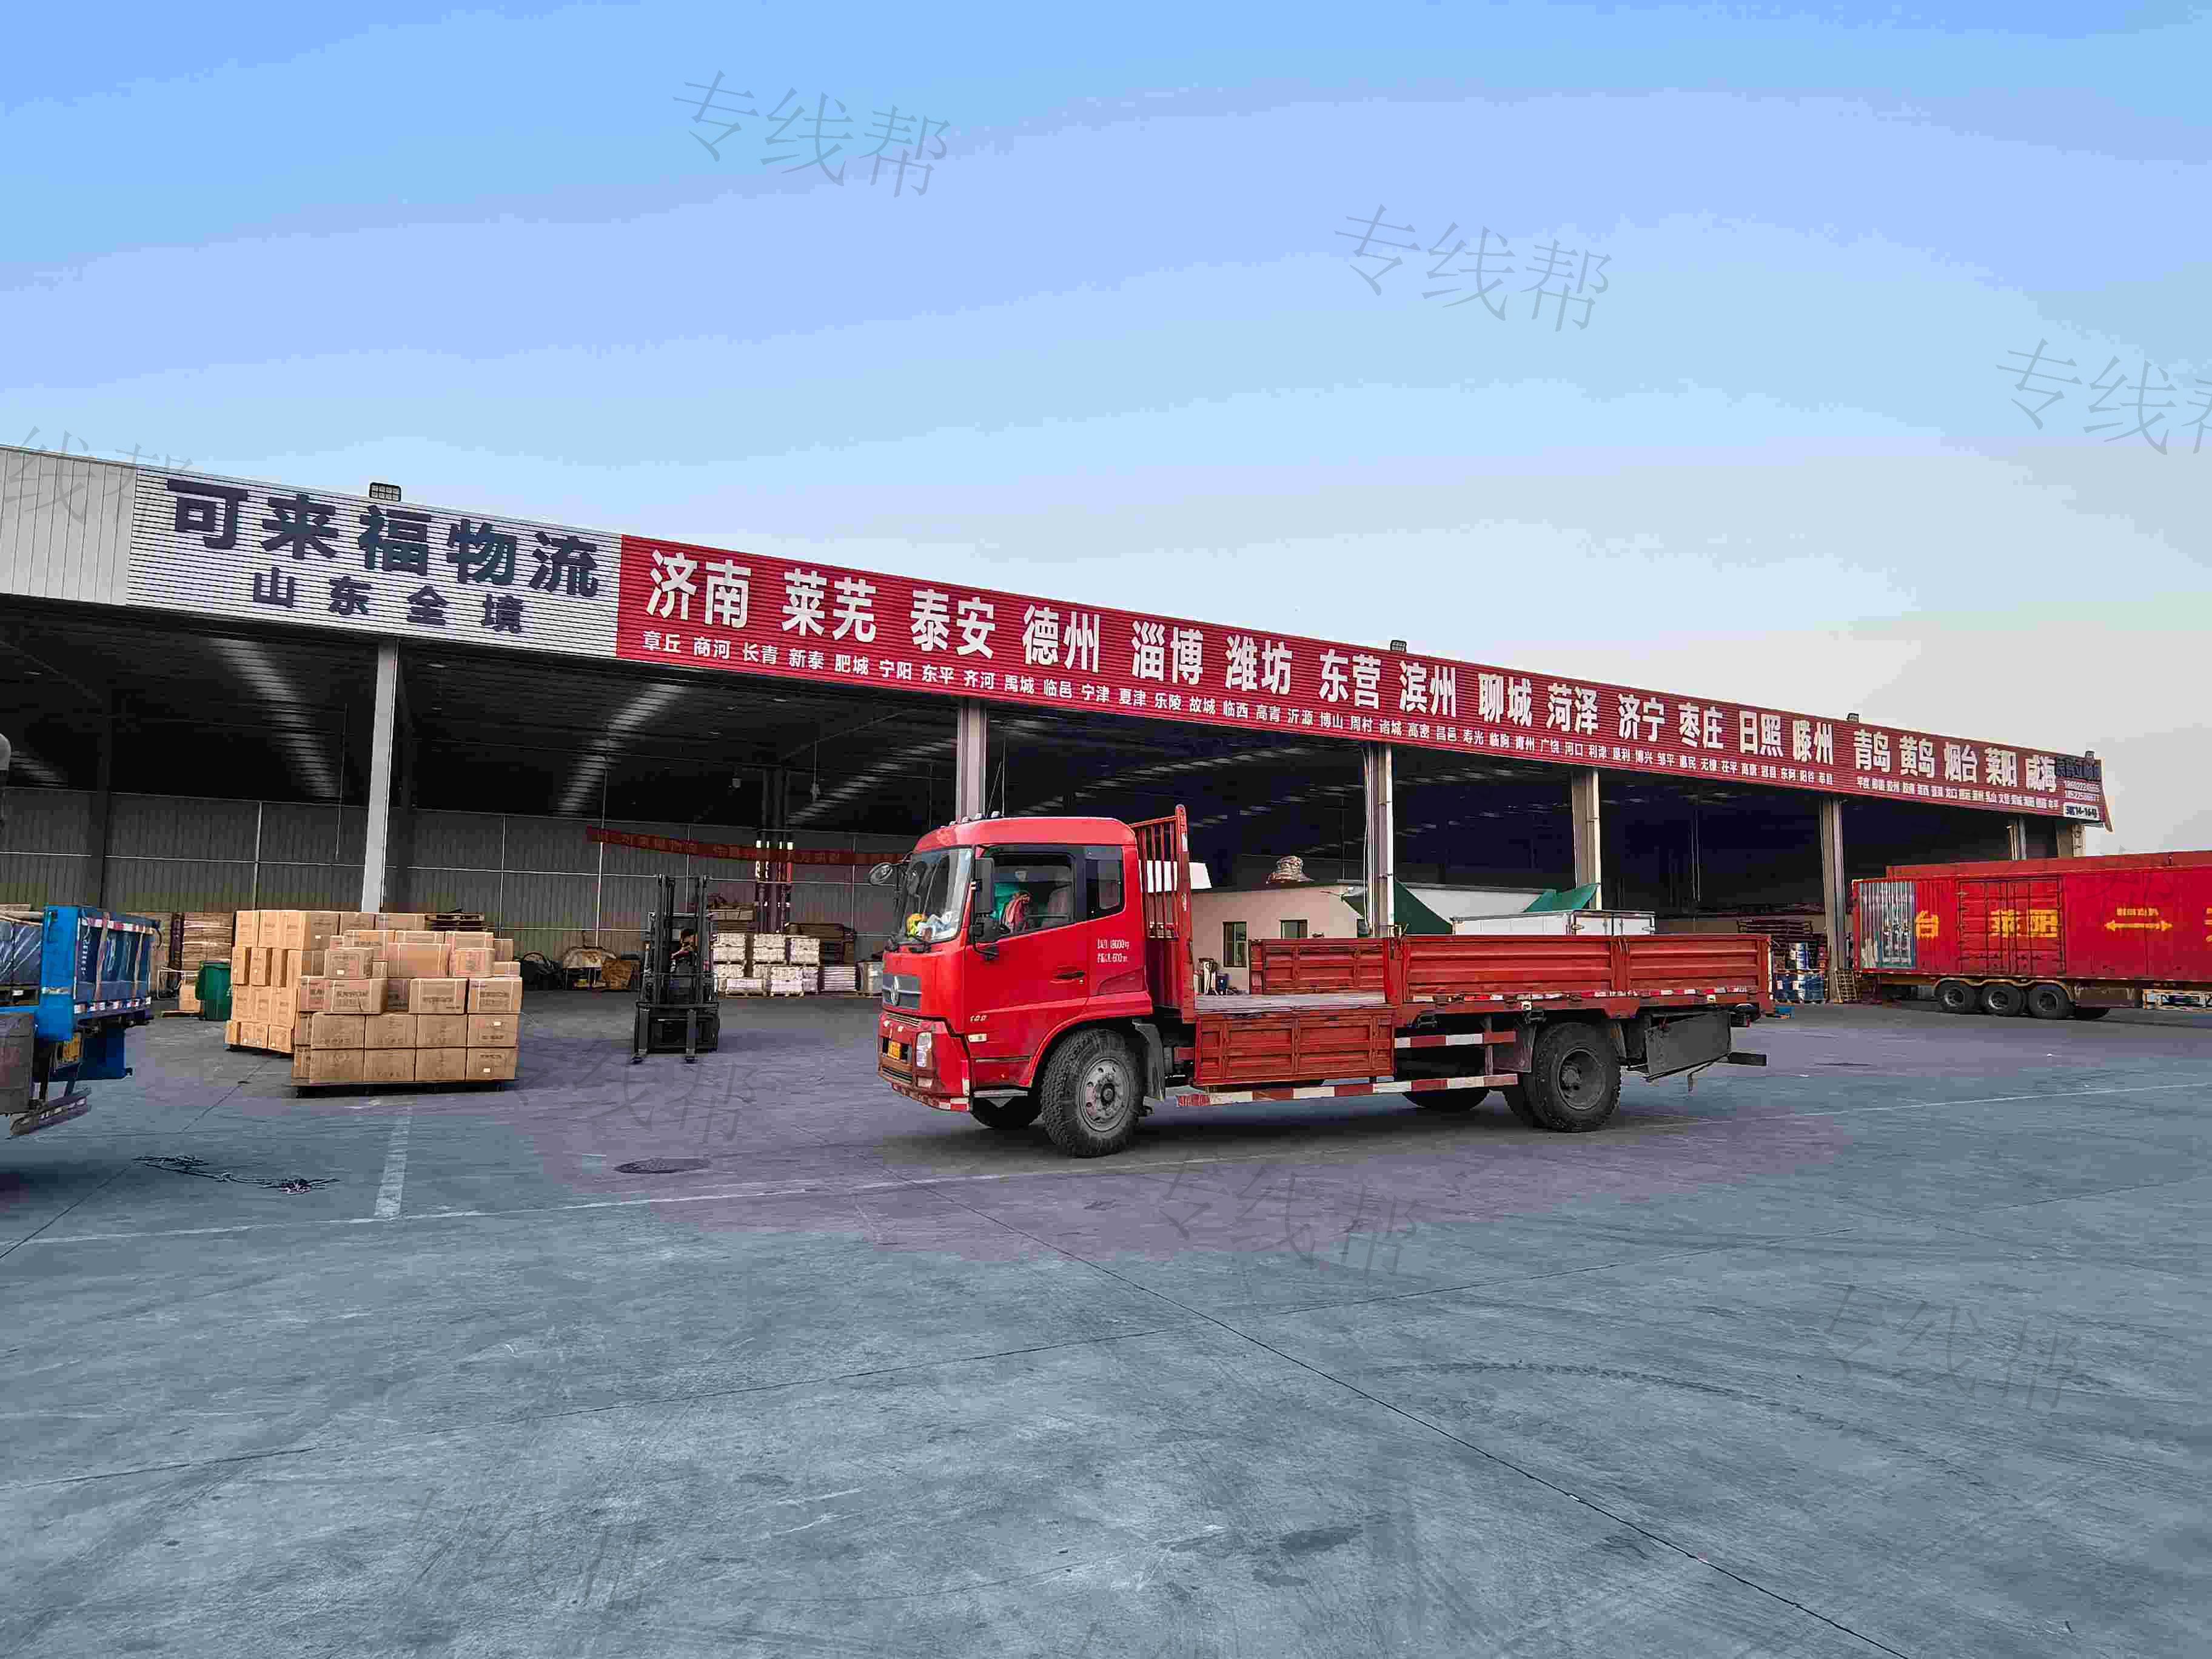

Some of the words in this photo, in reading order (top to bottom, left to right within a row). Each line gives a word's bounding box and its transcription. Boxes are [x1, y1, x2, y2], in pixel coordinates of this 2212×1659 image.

[167, 478, 599, 597] 可来福物流
[253, 566, 525, 634] 山东全境
[644, 631, 680, 652] 章丘
[694, 637, 730, 660] 商河
[743, 643, 777, 665] 长青
[789, 648, 823, 669] 新泰
[835, 654, 868, 675] 肥城
[879, 660, 911, 680] 宁阳
[922, 665, 954, 684] 东平
[964, 669, 994, 689] 齐河
[1005, 675, 1034, 694] 禹城
[1044, 679, 1071, 698] 临邑
[1082, 684, 1109, 702] 宁津
[1120, 688, 1145, 706] 夏津
[1155, 692, 1181, 710] 乐陵
[1190, 696, 1215, 714] 故城
[1224, 700, 1247, 718] 临西
[1256, 705, 1280, 722] 高青
[1288, 708, 1313, 725] 沂源
[1321, 712, 1342, 729] 博山
[1350, 716, 1372, 732] 周村
[1380, 720, 1401, 736] 诸城
[1409, 723, 1429, 739] 高密
[1464, 729, 1483, 745] 寿光
[646, 549, 751, 628] 济南
[782, 568, 876, 643] 莱芜
[910, 588, 996, 659] 泰安
[1022, 605, 1099, 673] 德州
[1131, 620, 1204, 685] 淄博
[1225, 635, 1293, 694] 潍坊
[1319, 649, 1381, 709] 东营
[1399, 660, 1456, 718] 滨州
[1478, 673, 1532, 726] 聊城
[1546, 682, 1598, 736] 菏泽
[1617, 693, 1664, 742] 济宁
[1678, 702, 1723, 749] 枣庄
[1739, 710, 1783, 757] 日照
[1854, 729, 1891, 773] 青岛
[1899, 736, 1936, 779] 黄岛
[1944, 742, 1977, 783] 烟台
